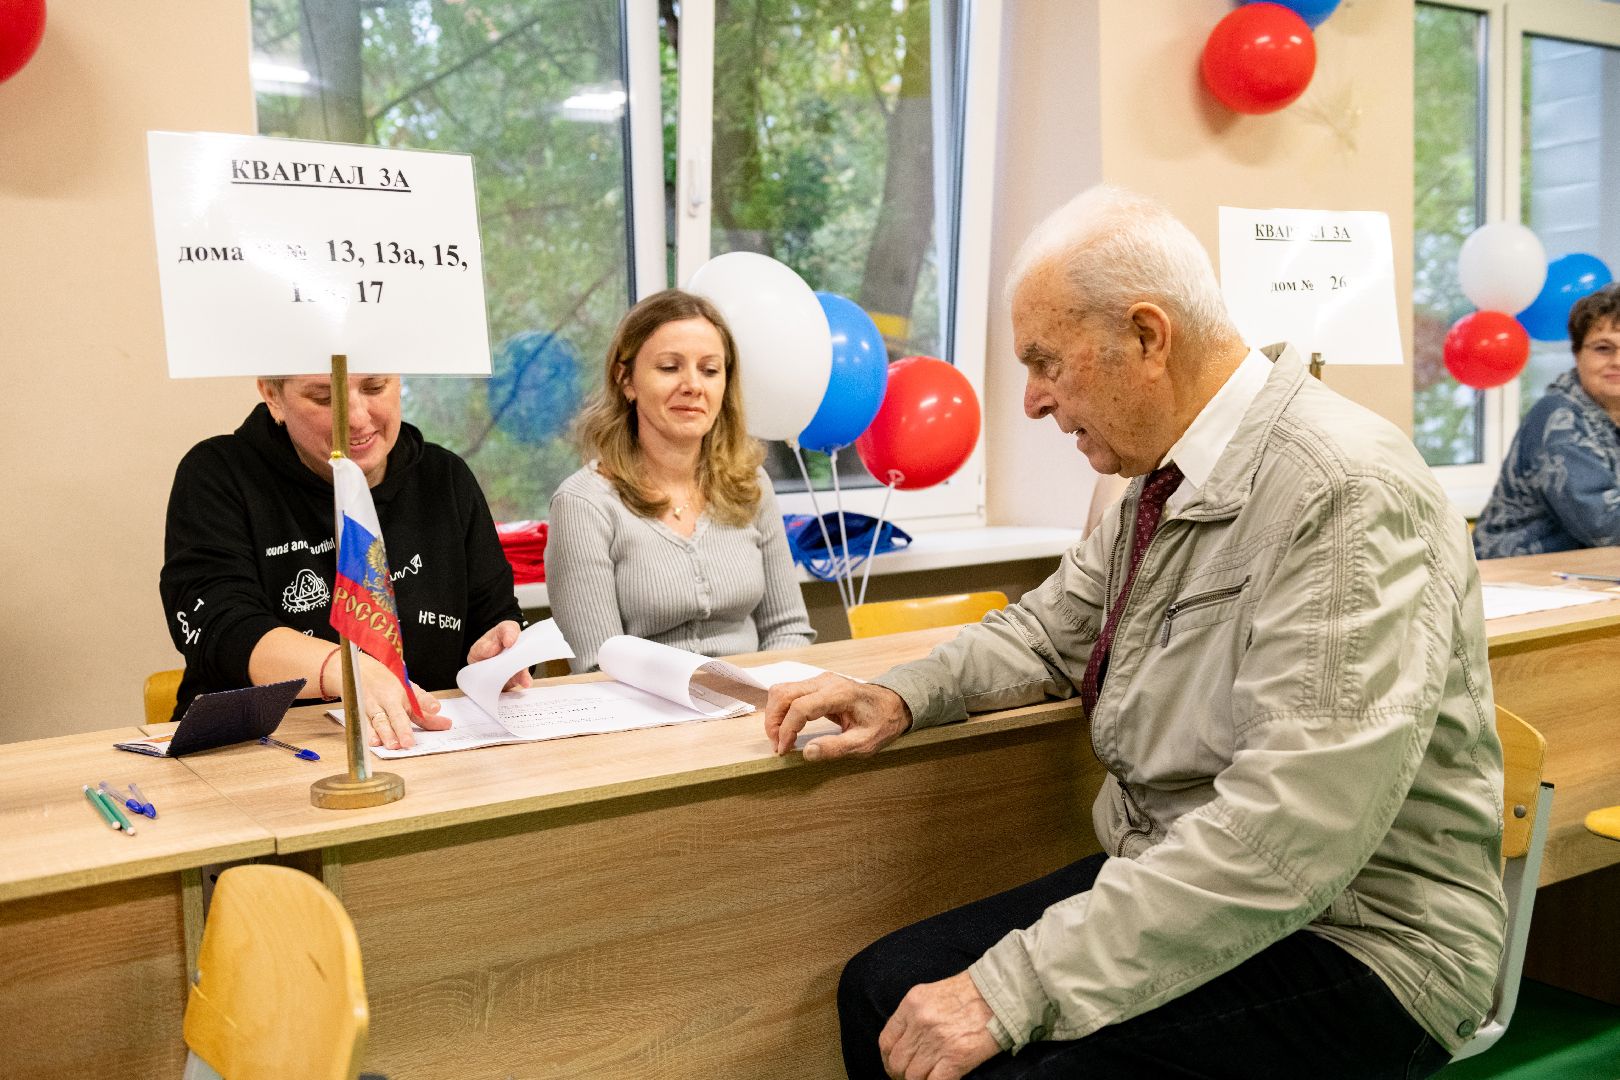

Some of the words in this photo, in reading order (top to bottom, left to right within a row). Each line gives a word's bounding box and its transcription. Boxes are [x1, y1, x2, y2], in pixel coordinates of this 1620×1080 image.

[231, 159, 365, 185] КВАРТАЛ
[178, 245, 245, 264] дома
[326, 239, 365, 268] 13,
[373, 241, 425, 269] 13а,
[432, 244, 469, 271] 15,
[356, 280, 384, 304] 17
[418, 610, 436, 625] НЕ
